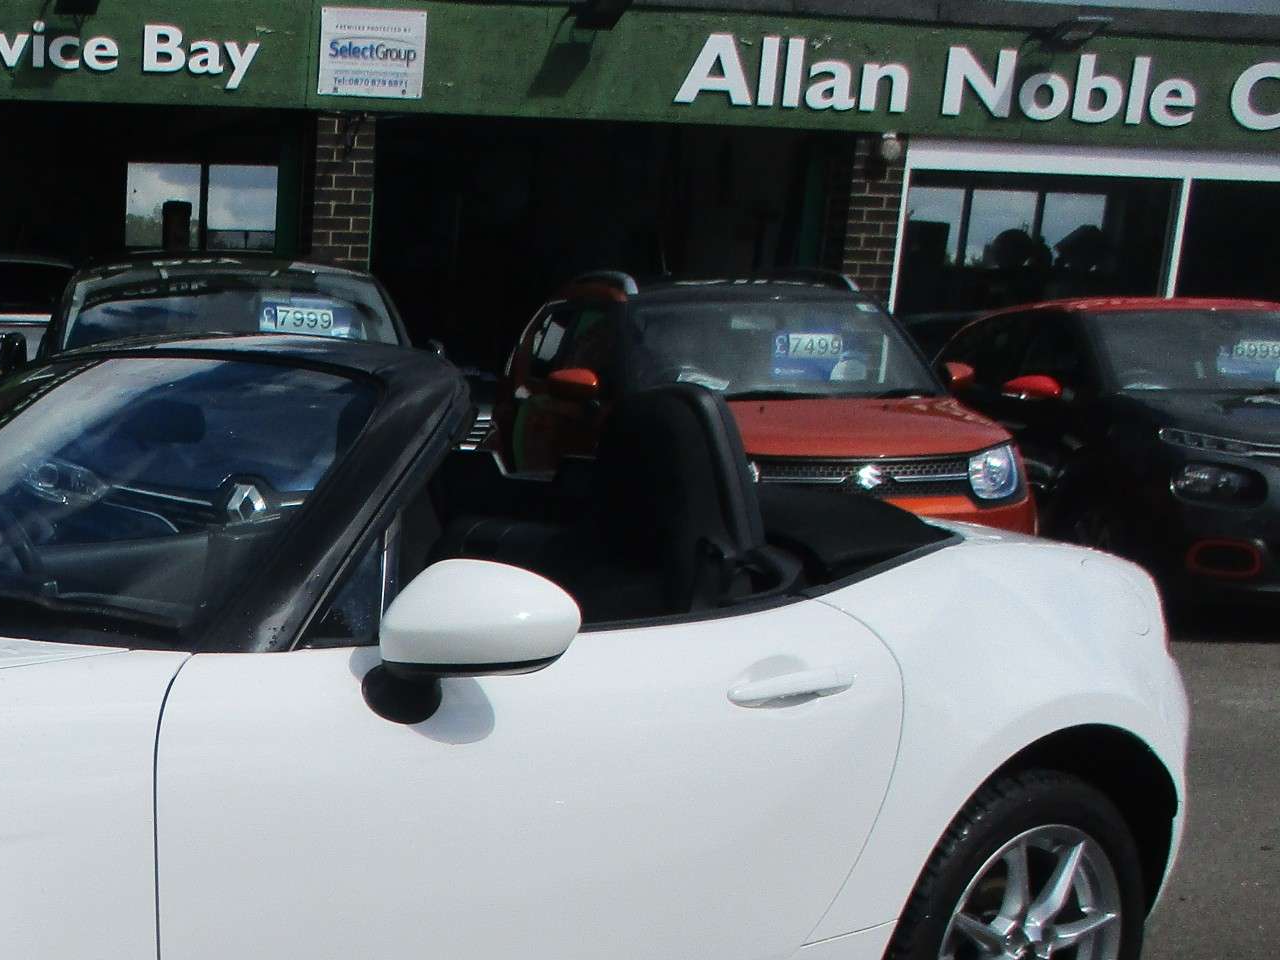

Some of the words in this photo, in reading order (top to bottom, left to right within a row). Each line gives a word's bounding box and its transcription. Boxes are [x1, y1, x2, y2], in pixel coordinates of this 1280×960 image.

[142, 23, 261, 90] Bay
[328, 40, 417, 67] SelectGroup
[673, 33, 910, 113] Allan
[940, 45, 1198, 127] Noble
